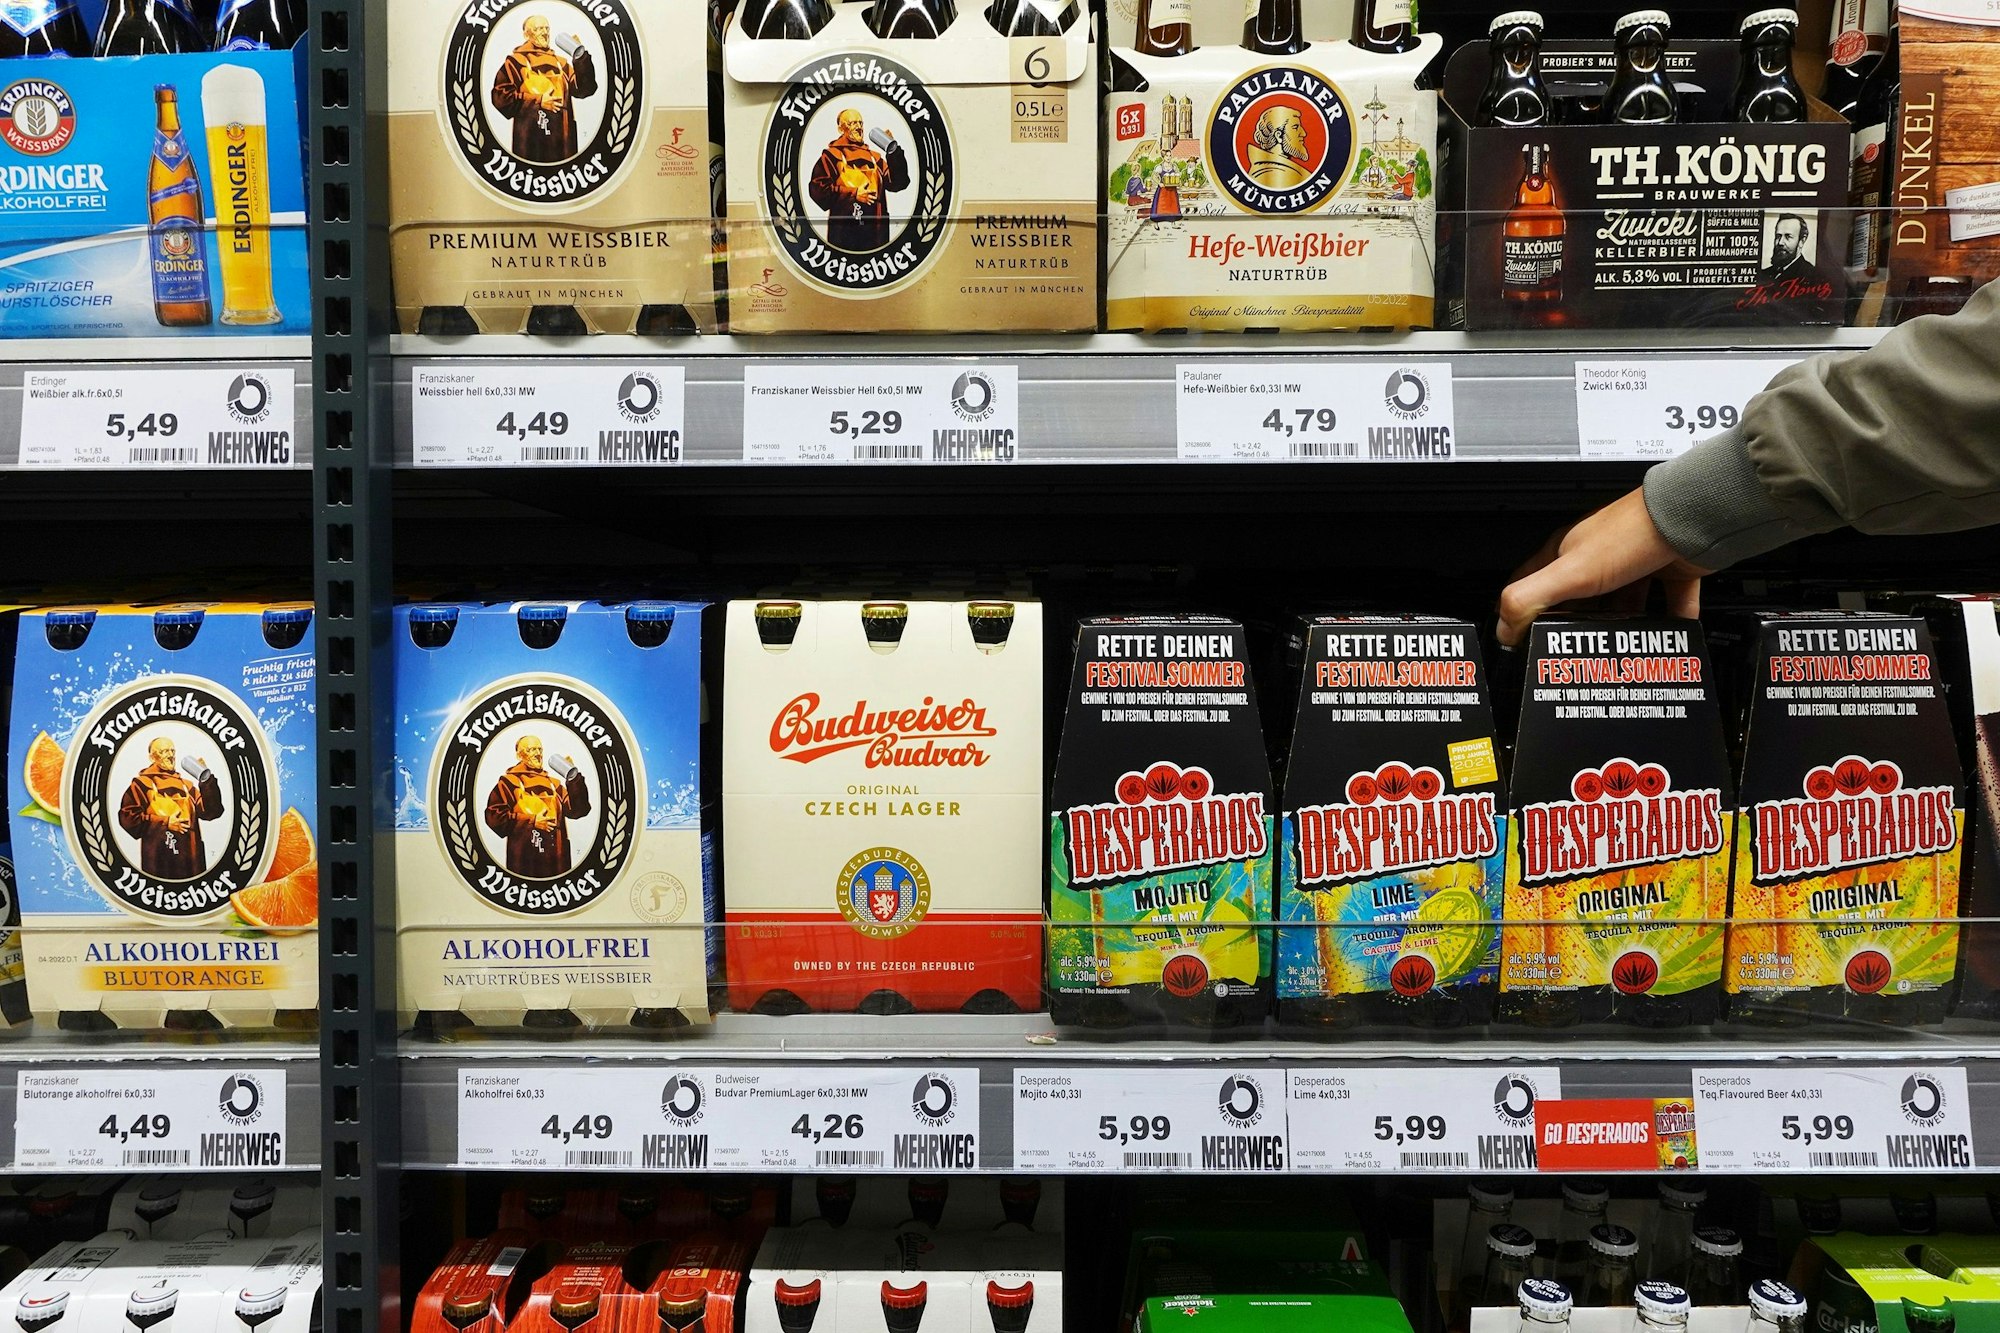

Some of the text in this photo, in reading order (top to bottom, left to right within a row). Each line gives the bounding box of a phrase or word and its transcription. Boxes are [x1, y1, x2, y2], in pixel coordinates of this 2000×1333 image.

[781, 57, 930, 126] Franziskaner
[1218, 71, 1343, 125] PAULANER
[1120, 109, 1140, 124] 6x
[1591, 137, 1826, 186] TH.KÖNIG
[1897, 92, 1935, 245] DUNKEL
[484, 150, 608, 197] Weissbier
[228, 142, 251, 254] ERDINGER
[1227, 173, 1332, 210] MÜNCHEN
[1654, 189, 1761, 200] BRAUWERKE
[975, 215, 1067, 230] PREMIUM
[1596, 208, 1697, 245] Zwickl
[1707, 218, 1732, 227] SÜFFIG
[430, 232, 670, 249] PREMIUM WEISSBIER
[970, 235, 1072, 247] WEISSBIER
[1188, 232, 1370, 265] Hefe-Weißbier
[1506, 239, 1562, 254] TH.KÖNIG
[1629, 238, 1696, 246] NATURBELASSENES
[1706, 235, 1759, 247] MIT 100%
[800, 238, 917, 283] Weissbier
[1596, 247, 1696, 258] KELLERBIER
[1706, 248, 1758, 256] AROMAHOPFEN
[155, 259, 204, 272] ERDINGER
[492, 255, 607, 268] NATURTRÜB
[975, 257, 1069, 269] NATURTRÜB
[1229, 266, 1328, 281] NATURTRÜB
[1595, 269, 1682, 284] ALK. 5,3% VOL
[5, 281, 94, 293] SPRITZIGER
[473, 288, 624, 299] GEBRAUT MÜNCHEN
[961, 285, 1084, 294] GEBRAUT MÜNCHEN
[1190, 304, 1365, 319] Original Bierspezialität
[31, 377, 66, 386] Erdinger
[420, 374, 474, 383] Franziskaner
[1184, 372, 1221, 380] Paulaner
[1583, 368, 1646, 378] Theodor König
[30, 389, 69, 398] Weißbier
[420, 386, 535, 396] Weissbier hell MW
[752, 386, 922, 395] Franziskaner Weissbier Hell MW
[1184, 384, 1301, 394] Hefe-Weißbier MW
[1583, 382, 1612, 390] Zwickl
[107, 413, 178, 442] 5,49
[496, 412, 568, 441] 4,49
[830, 410, 902, 440] 5,29
[1263, 408, 1336, 437] 4,79
[1665, 406, 1738, 434] 3,99
[208, 431, 289, 463] MEHRWEG
[599, 430, 679, 462] MEHRWEG
[933, 429, 1014, 462] MEHRWEG
[1368, 426, 1450, 460] MEHRWEG
[1098, 635, 1233, 657] RETTE DEINEN
[1327, 635, 1464, 657] RETTE DEINEN
[1547, 631, 1688, 654] RETTE DEINEN
[1778, 628, 1917, 652] RETTE DEINEN
[243, 658, 316, 675] Fruchtig frisch
[1087, 662, 1245, 687] FESTIVALSOMMER
[1317, 661, 1476, 687] FESTIVALSOMMER
[1538, 657, 1701, 684] FESTIVALSOMMER
[1770, 654, 1930, 681] FESTIVALSOMMER
[1082, 690, 1248, 705] GEWINNE VON 100 PREISEN FÜR DEINEN FESTIVALSOMMER.
[91, 691, 245, 755] Franziskaner
[457, 689, 613, 752] Franziskaner
[770, 692, 997, 754] Budweiser
[865, 733, 991, 769] Budvar
[847, 785, 919, 795] ORIGINAL
[805, 801, 961, 816] CZECH LAGER
[1069, 797, 1264, 880] DESPERADOS
[1299, 797, 1495, 880] DESPERADOS
[1524, 792, 1720, 876] DESPERADOS
[1757, 789, 1953, 875] DESPERADOS
[114, 866, 238, 911] Weissbier
[478, 865, 601, 911] Weissbier
[1133, 880, 1212, 912] MOJITO
[1372, 883, 1416, 909] LIME
[1811, 880, 1903, 914] ORIGINAL
[1579, 881, 1670, 915] ORIGINAL
[1135, 931, 1181, 943] TEQUILA
[1353, 931, 1399, 942] TEQUILA
[1585, 926, 1631, 939] TEQUILA
[85, 942, 280, 963] ALKOHOLFREI
[442, 937, 650, 961] ALKOHOLFREI
[1363, 938, 1438, 956] CACTUS LIME
[794, 961, 975, 970] OWNED BY THE CZECH REPUBLIC
[105, 970, 264, 987] BLUTORANGE
[443, 971, 652, 986] NATURTRÜBES WEISSBIER
[1074, 970, 1099, 982] 330ml
[25, 1076, 79, 1086] Franziskaner
[465, 1076, 519, 1085] Franziskaner
[715, 1074, 759, 1084] Budweiser
[1021, 1076, 1071, 1087] Desperados
[1294, 1077, 1345, 1087] Desperados
[1700, 1076, 1750, 1086] Desperados
[24, 1089, 122, 1100] Blutorange alkoholfrei
[465, 1089, 545, 1099] Alkoholfrei 6x0,33
[715, 1088, 868, 1099] Budvar PremiumLager MW
[1021, 1089, 1048, 1100] Mojito
[1295, 1090, 1316, 1099] Lime
[1700, 1090, 1788, 1100] Teq.Flavoured Beer
[99, 1114, 171, 1143] 4,49
[541, 1114, 613, 1144] 4,49
[791, 1114, 864, 1144] 4,26
[1099, 1116, 1170, 1146] 5,99
[1374, 1115, 1446, 1146] 5,99
[1544, 1122, 1648, 1145] GO DESPERADOS
[1782, 1115, 1854, 1145] 5,99
[201, 1132, 280, 1166] MEHRWEG
[894, 1134, 974, 1168] MEHRWEG
[1202, 1135, 1282, 1170] MEHRWEG
[1886, 1134, 1969, 1167] MEHRWEG
[1525, 1279, 1565, 1297] Corona
[1164, 1300, 1214, 1308] Heineken
